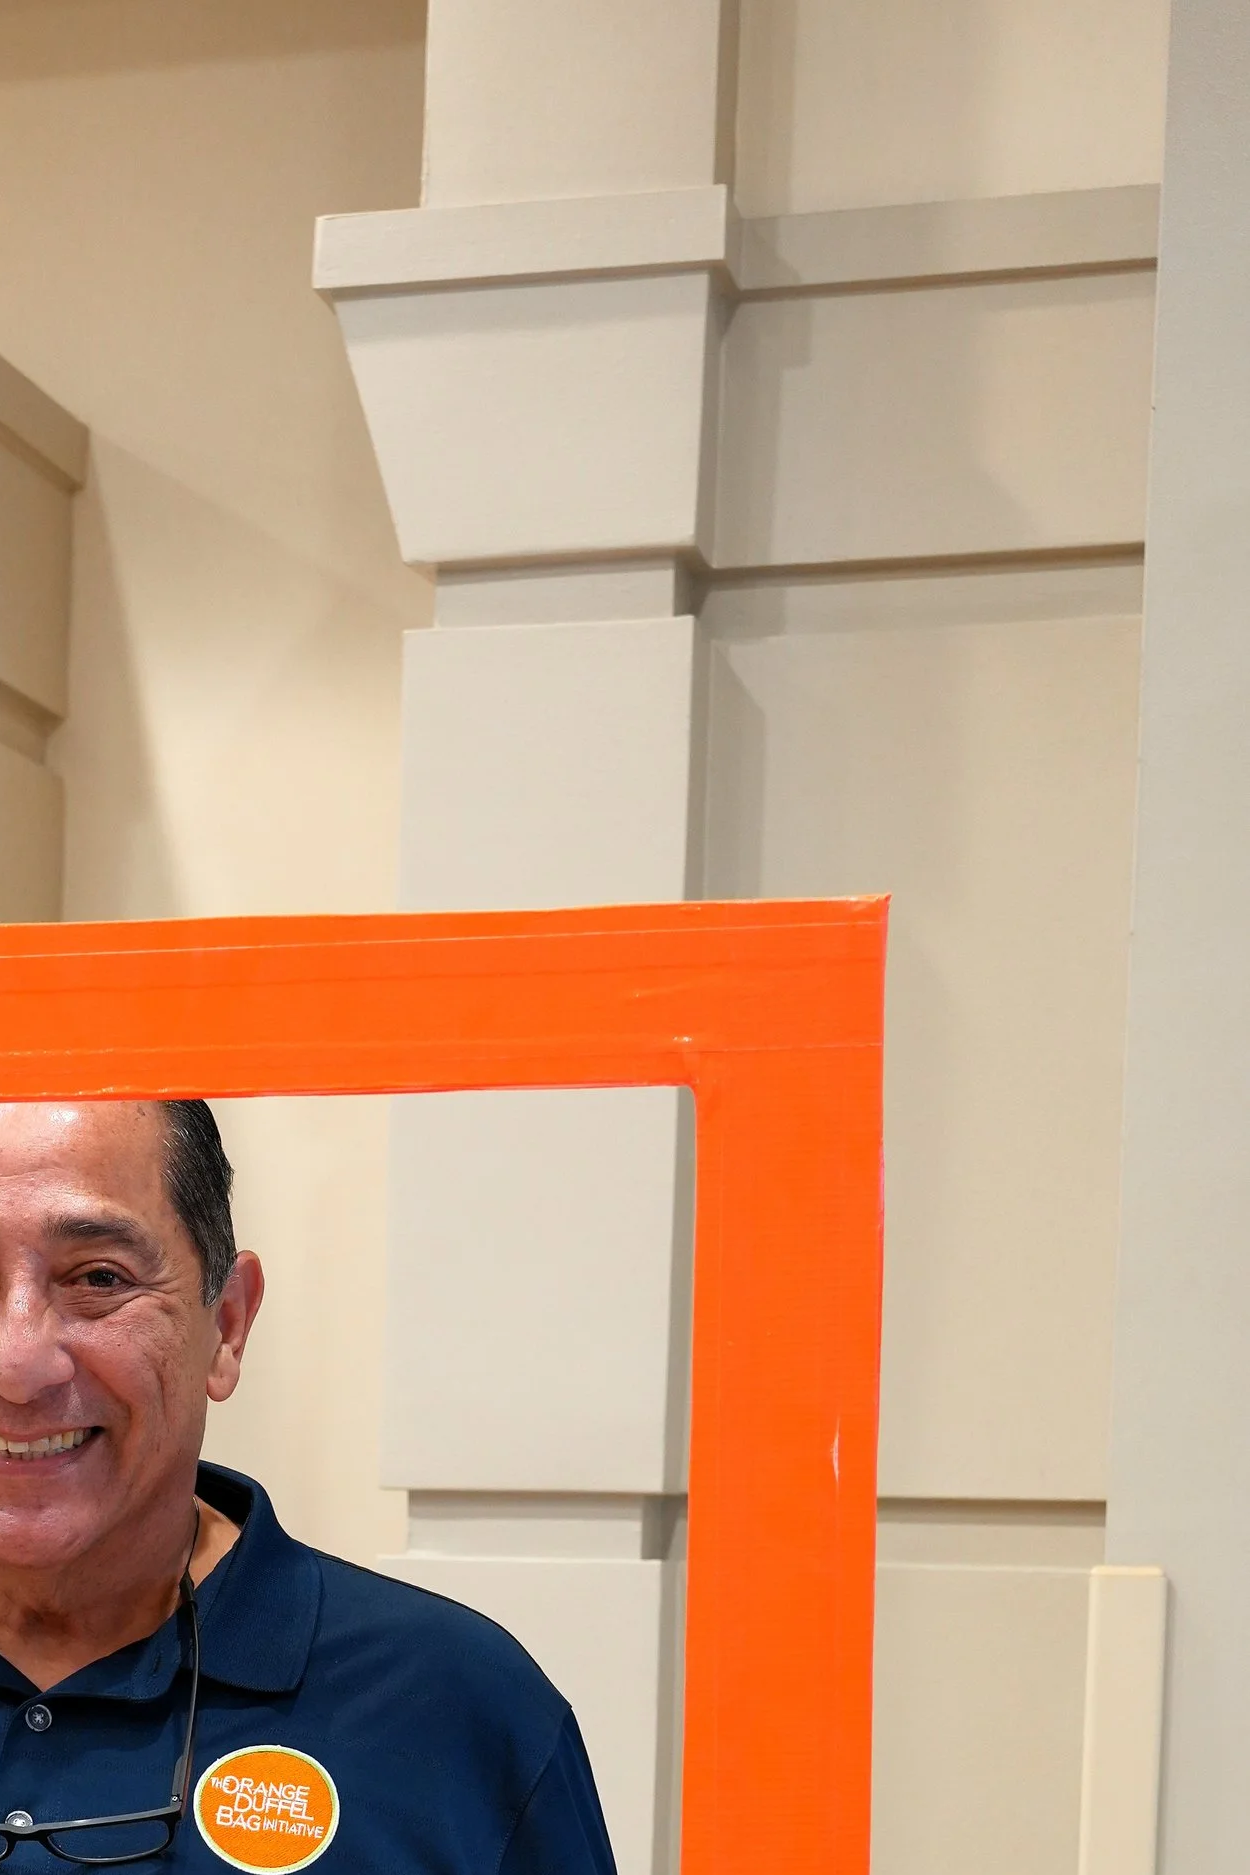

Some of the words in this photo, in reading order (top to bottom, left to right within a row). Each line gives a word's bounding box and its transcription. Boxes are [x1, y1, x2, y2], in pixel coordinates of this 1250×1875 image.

[210, 1776, 230, 1790] THE
[222, 1775, 310, 1802] ORANGE
[234, 1793, 314, 1821] DUFFEL
[216, 1805, 261, 1831] BAG
[263, 1816, 325, 1839] INITIATIVE
